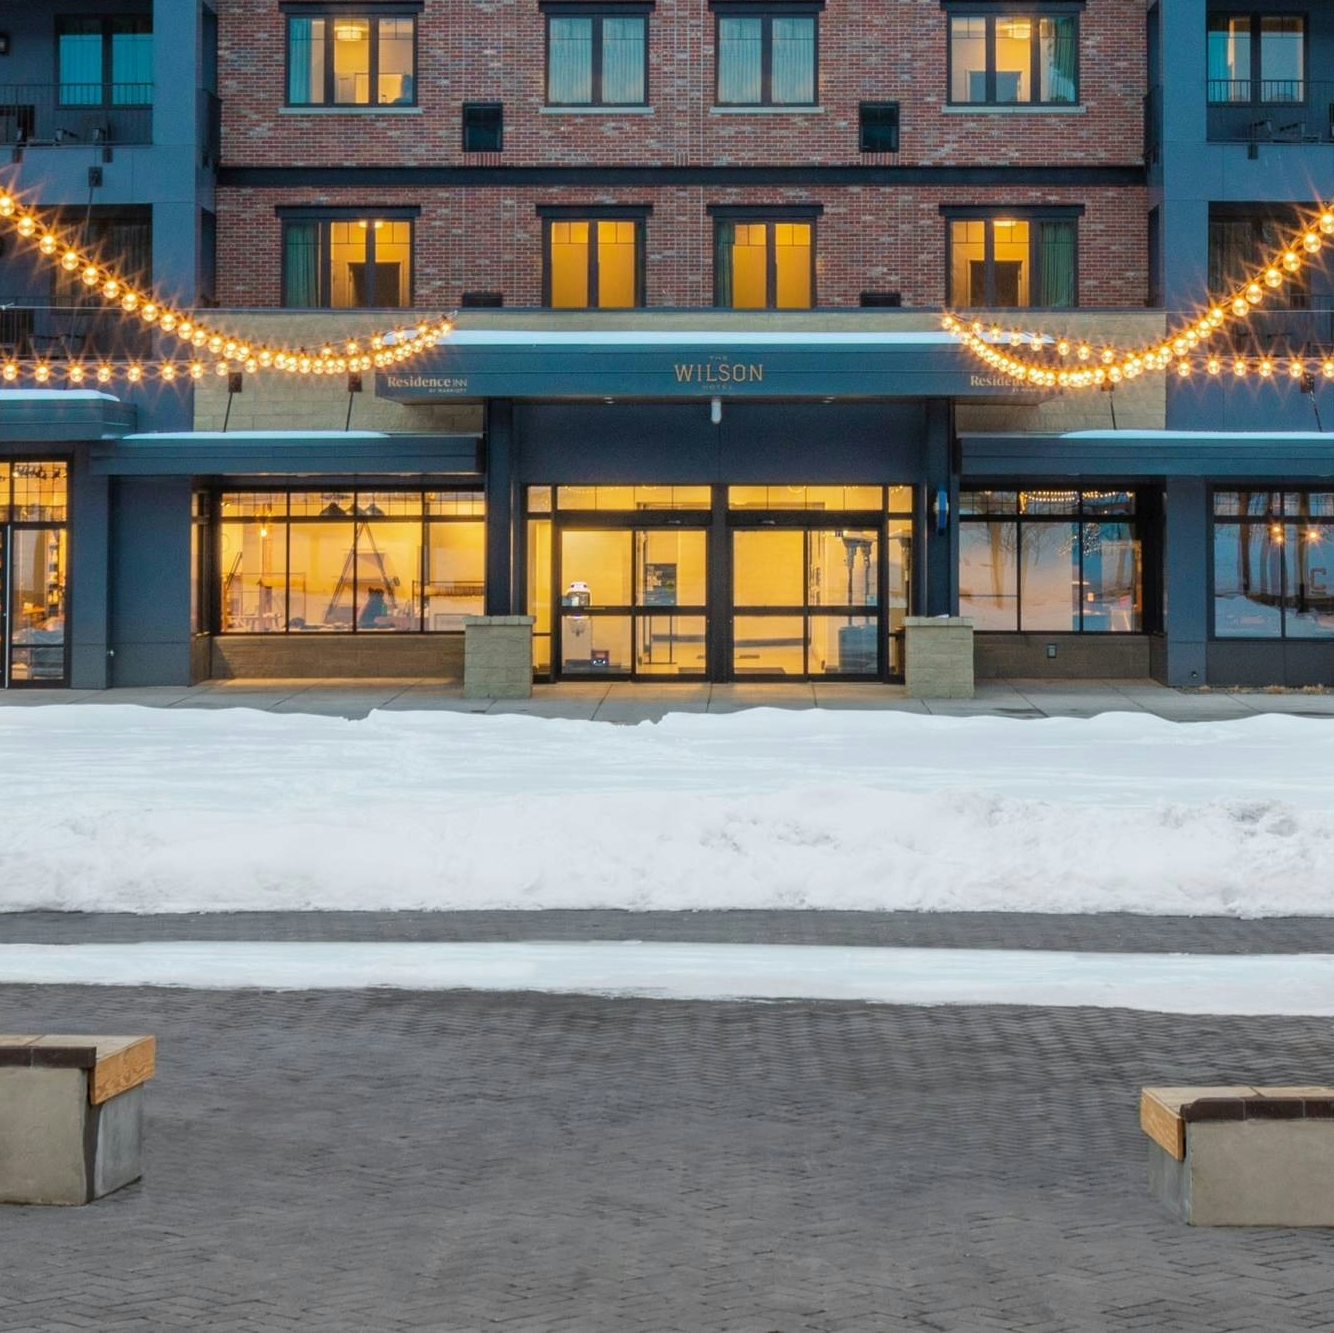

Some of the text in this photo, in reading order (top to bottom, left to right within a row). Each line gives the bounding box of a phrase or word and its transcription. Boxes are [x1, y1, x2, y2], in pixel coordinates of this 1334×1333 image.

[674, 364, 763, 382] WILSON
[387, 376, 467, 387] Residence INN
